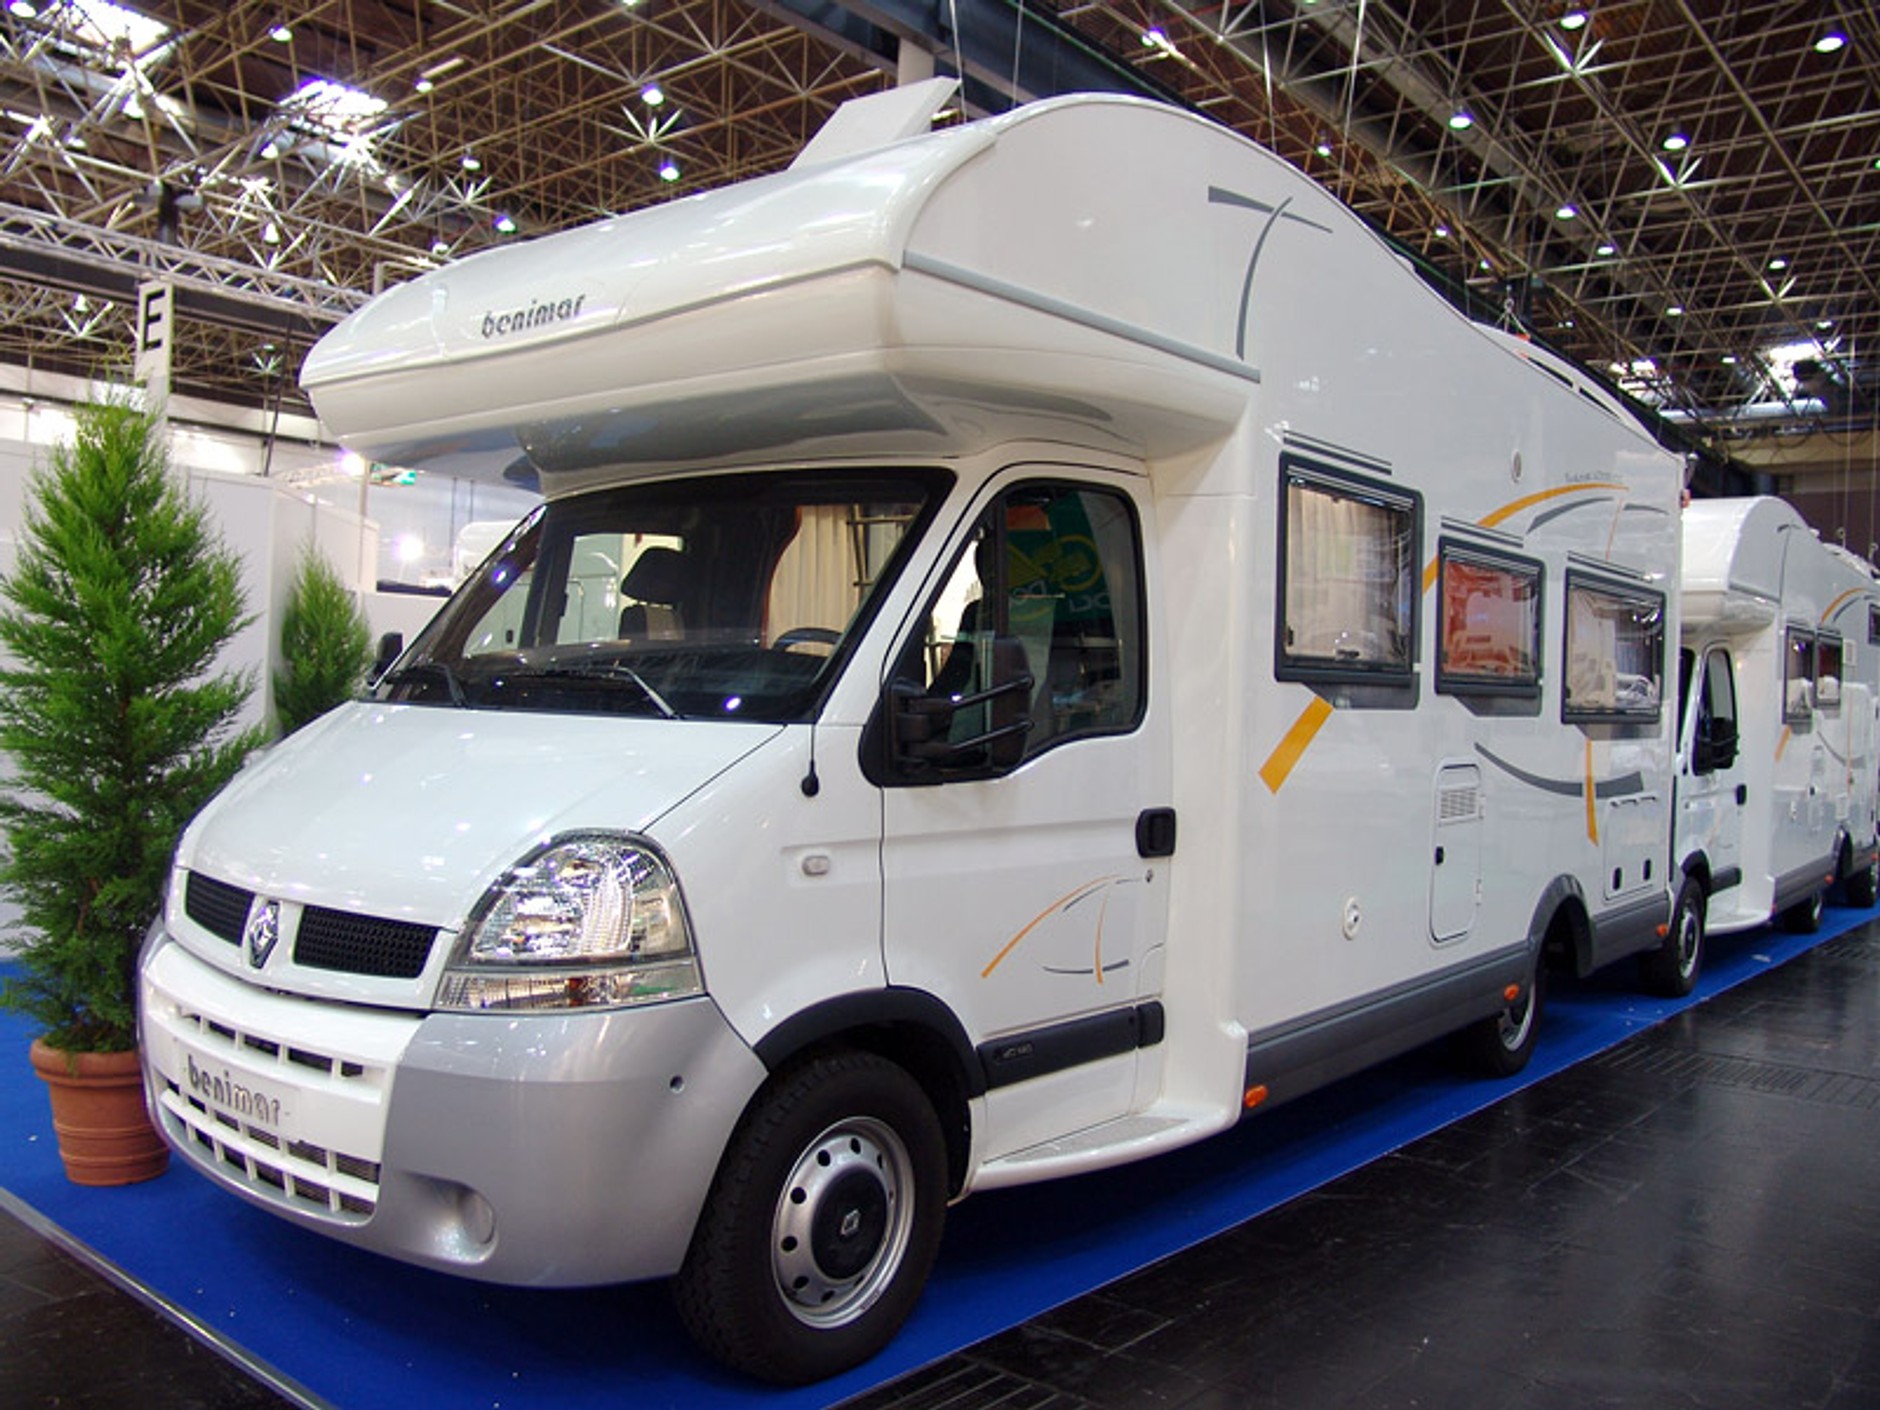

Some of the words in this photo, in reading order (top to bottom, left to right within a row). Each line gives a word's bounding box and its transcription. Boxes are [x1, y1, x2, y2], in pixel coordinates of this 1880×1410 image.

[144, 289, 165, 351] E
[481, 293, 586, 339] benimar
[187, 1053, 280, 1127] benimar
